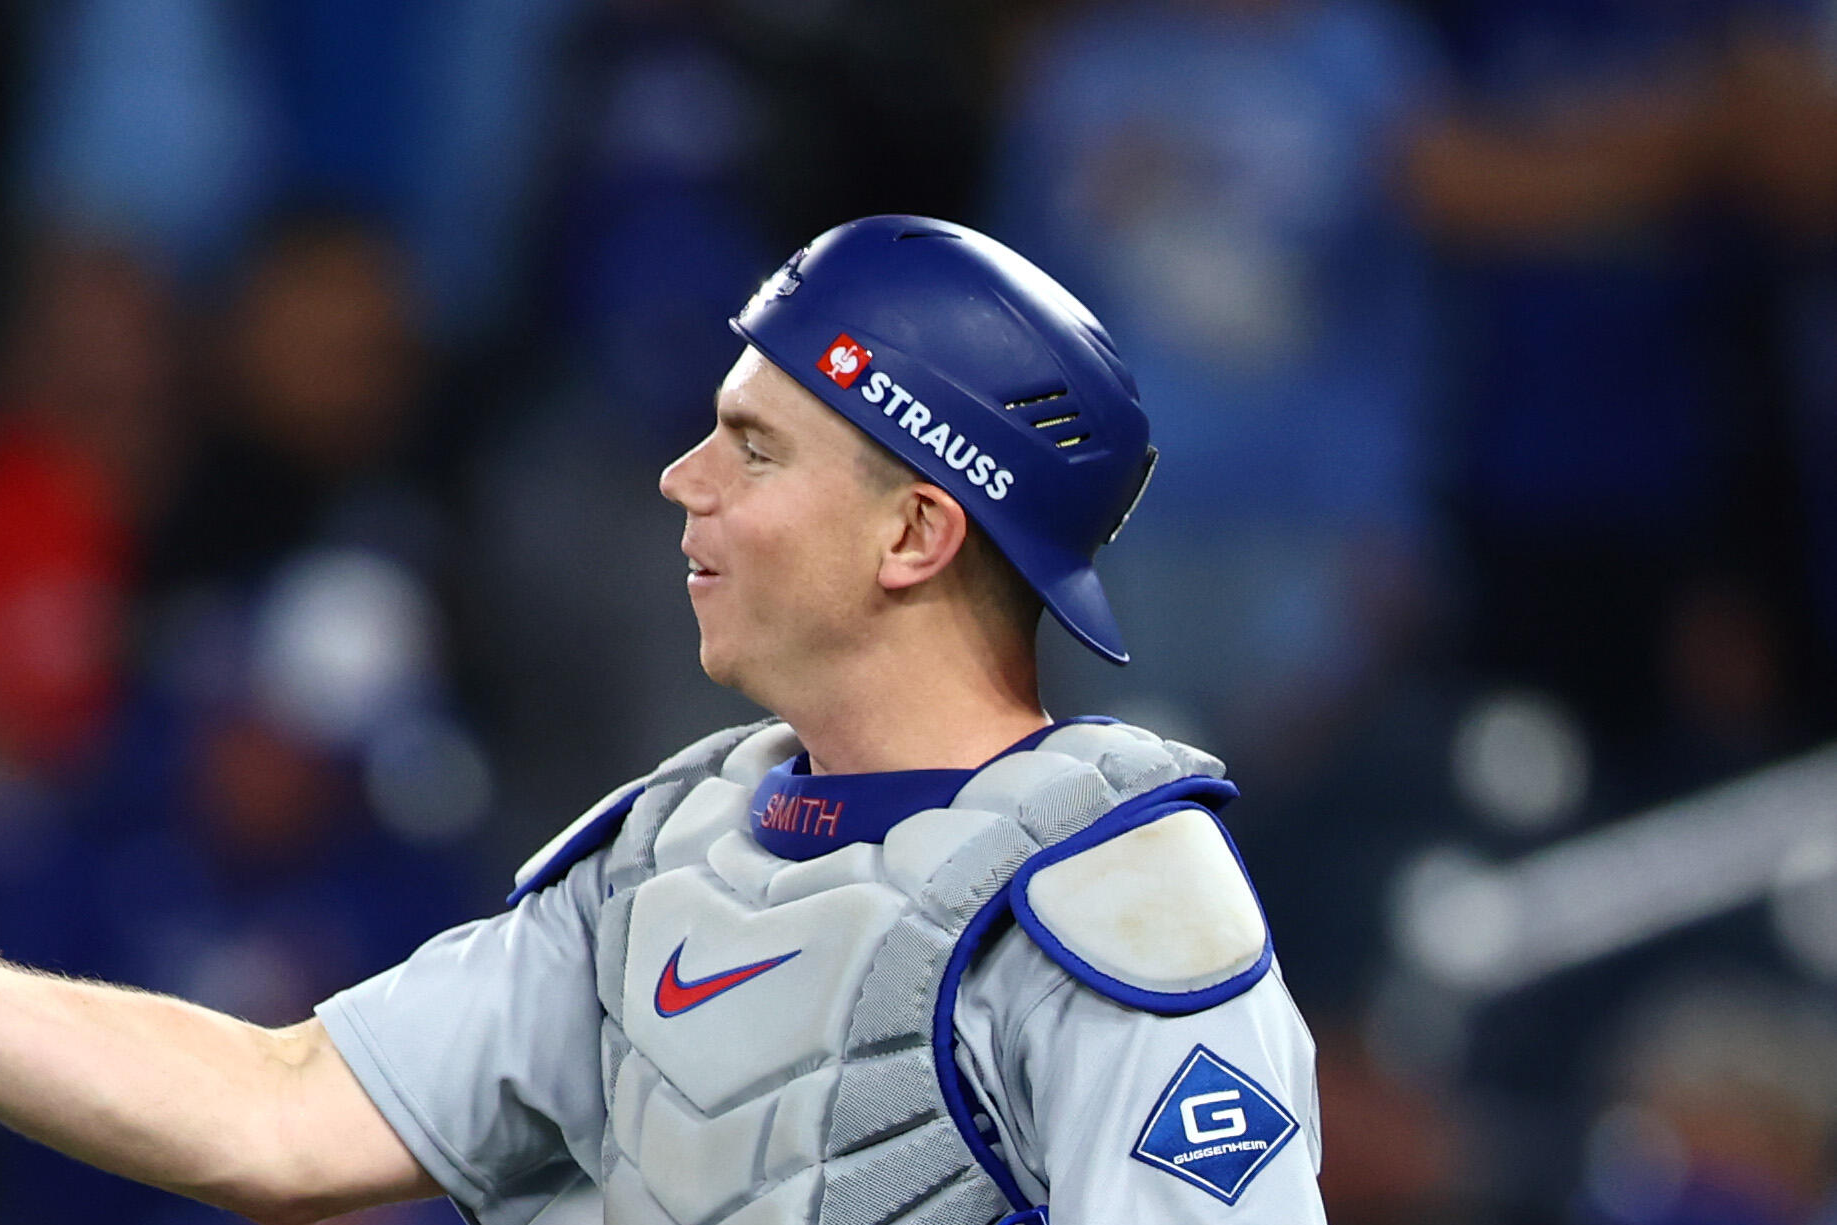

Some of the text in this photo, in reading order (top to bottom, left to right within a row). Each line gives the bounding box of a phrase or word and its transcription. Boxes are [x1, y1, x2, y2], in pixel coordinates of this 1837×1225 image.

[861, 371, 1014, 500] STRAUSS
[760, 792, 844, 837] SMITH
[1180, 1089, 1247, 1144] G
[1173, 1140, 1267, 1165] GUGGENHEIM
